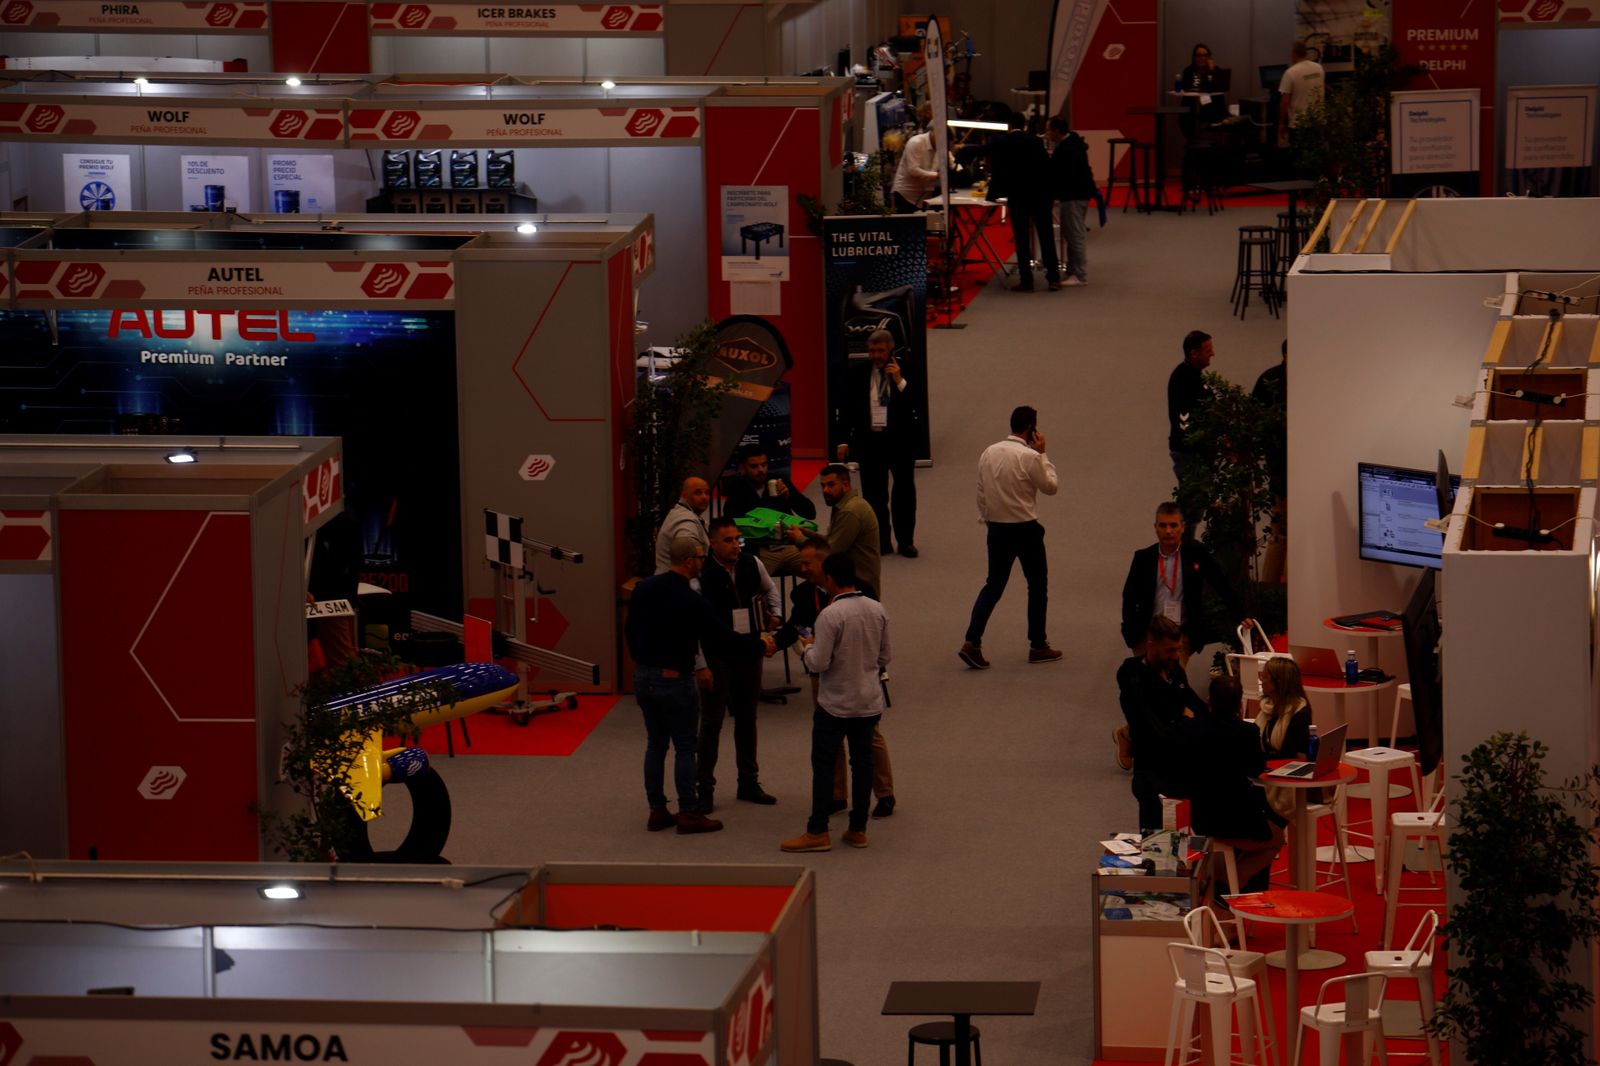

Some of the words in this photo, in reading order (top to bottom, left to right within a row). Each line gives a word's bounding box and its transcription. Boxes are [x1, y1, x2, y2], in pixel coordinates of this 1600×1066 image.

[102, 5, 139, 15] PHIRA
[477, 8, 505, 18] ICER
[508, 8, 556, 18] BRAKES
[1406, 28, 1479, 41] PREMIUM
[1418, 59, 1467, 71] DELPHI
[147, 110, 189, 122] WOLF
[503, 113, 545, 125] WOLF
[153, 125, 208, 134] PROFESIONAL
[486, 128, 508, 136] PEÑA
[510, 128, 563, 136] PROFESIONAL
[832, 233, 855, 242] THE
[859, 232, 893, 241] VITAL
[832, 245, 900, 257] LUBRICANT
[208, 268, 264, 281] AUTEL
[188, 285, 214, 295] PEÑA
[217, 287, 284, 295] PROFESIONAL
[108, 310, 316, 342] AUTEL
[141, 350, 214, 365] Premium
[225, 352, 288, 366] Partner
[325, 601, 350, 613] SAM
[210, 1033, 348, 1062] SAMOA
